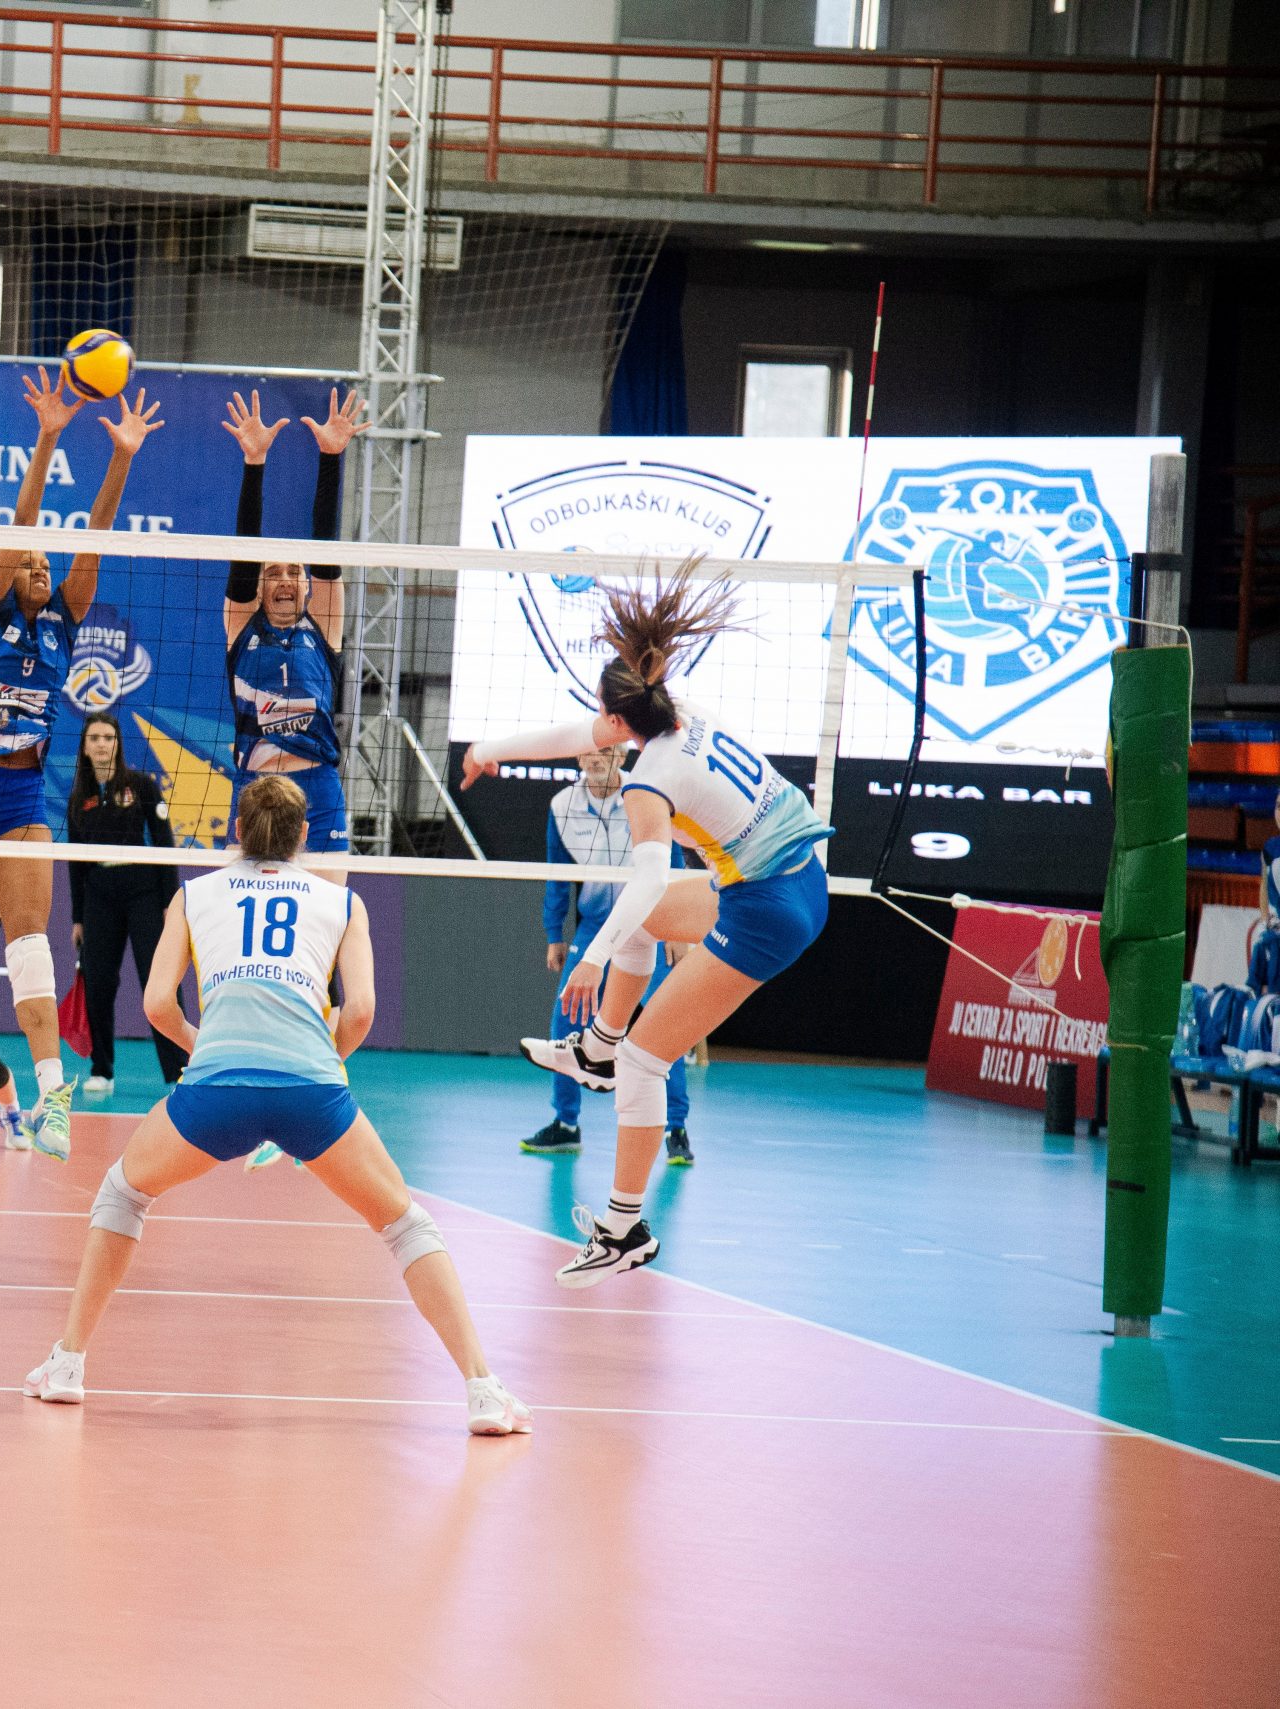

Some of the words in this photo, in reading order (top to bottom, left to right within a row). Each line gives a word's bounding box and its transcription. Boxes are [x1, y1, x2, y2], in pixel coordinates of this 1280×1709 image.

[530, 489, 670, 534] ODBOJKAŠKI
[675, 500, 732, 538] KLUB
[74, 626, 126, 652] UDVA
[1018, 601, 1103, 674] BAR
[279, 662, 289, 687] 1
[706, 731, 763, 804] 10
[868, 781, 985, 800] LUKA
[1002, 786, 1093, 805] BAR
[911, 832, 971, 860] 9
[228, 877, 311, 894] YAKUSHINA
[236, 895, 299, 958] 18
[228, 963, 282, 982] HERCEG
[962, 1002, 1001, 1041] CENTAR
[998, 1008, 1015, 1043] ZA
[1013, 1010, 1051, 1049] SPORT
[979, 1045, 1024, 1086] BIJELO
